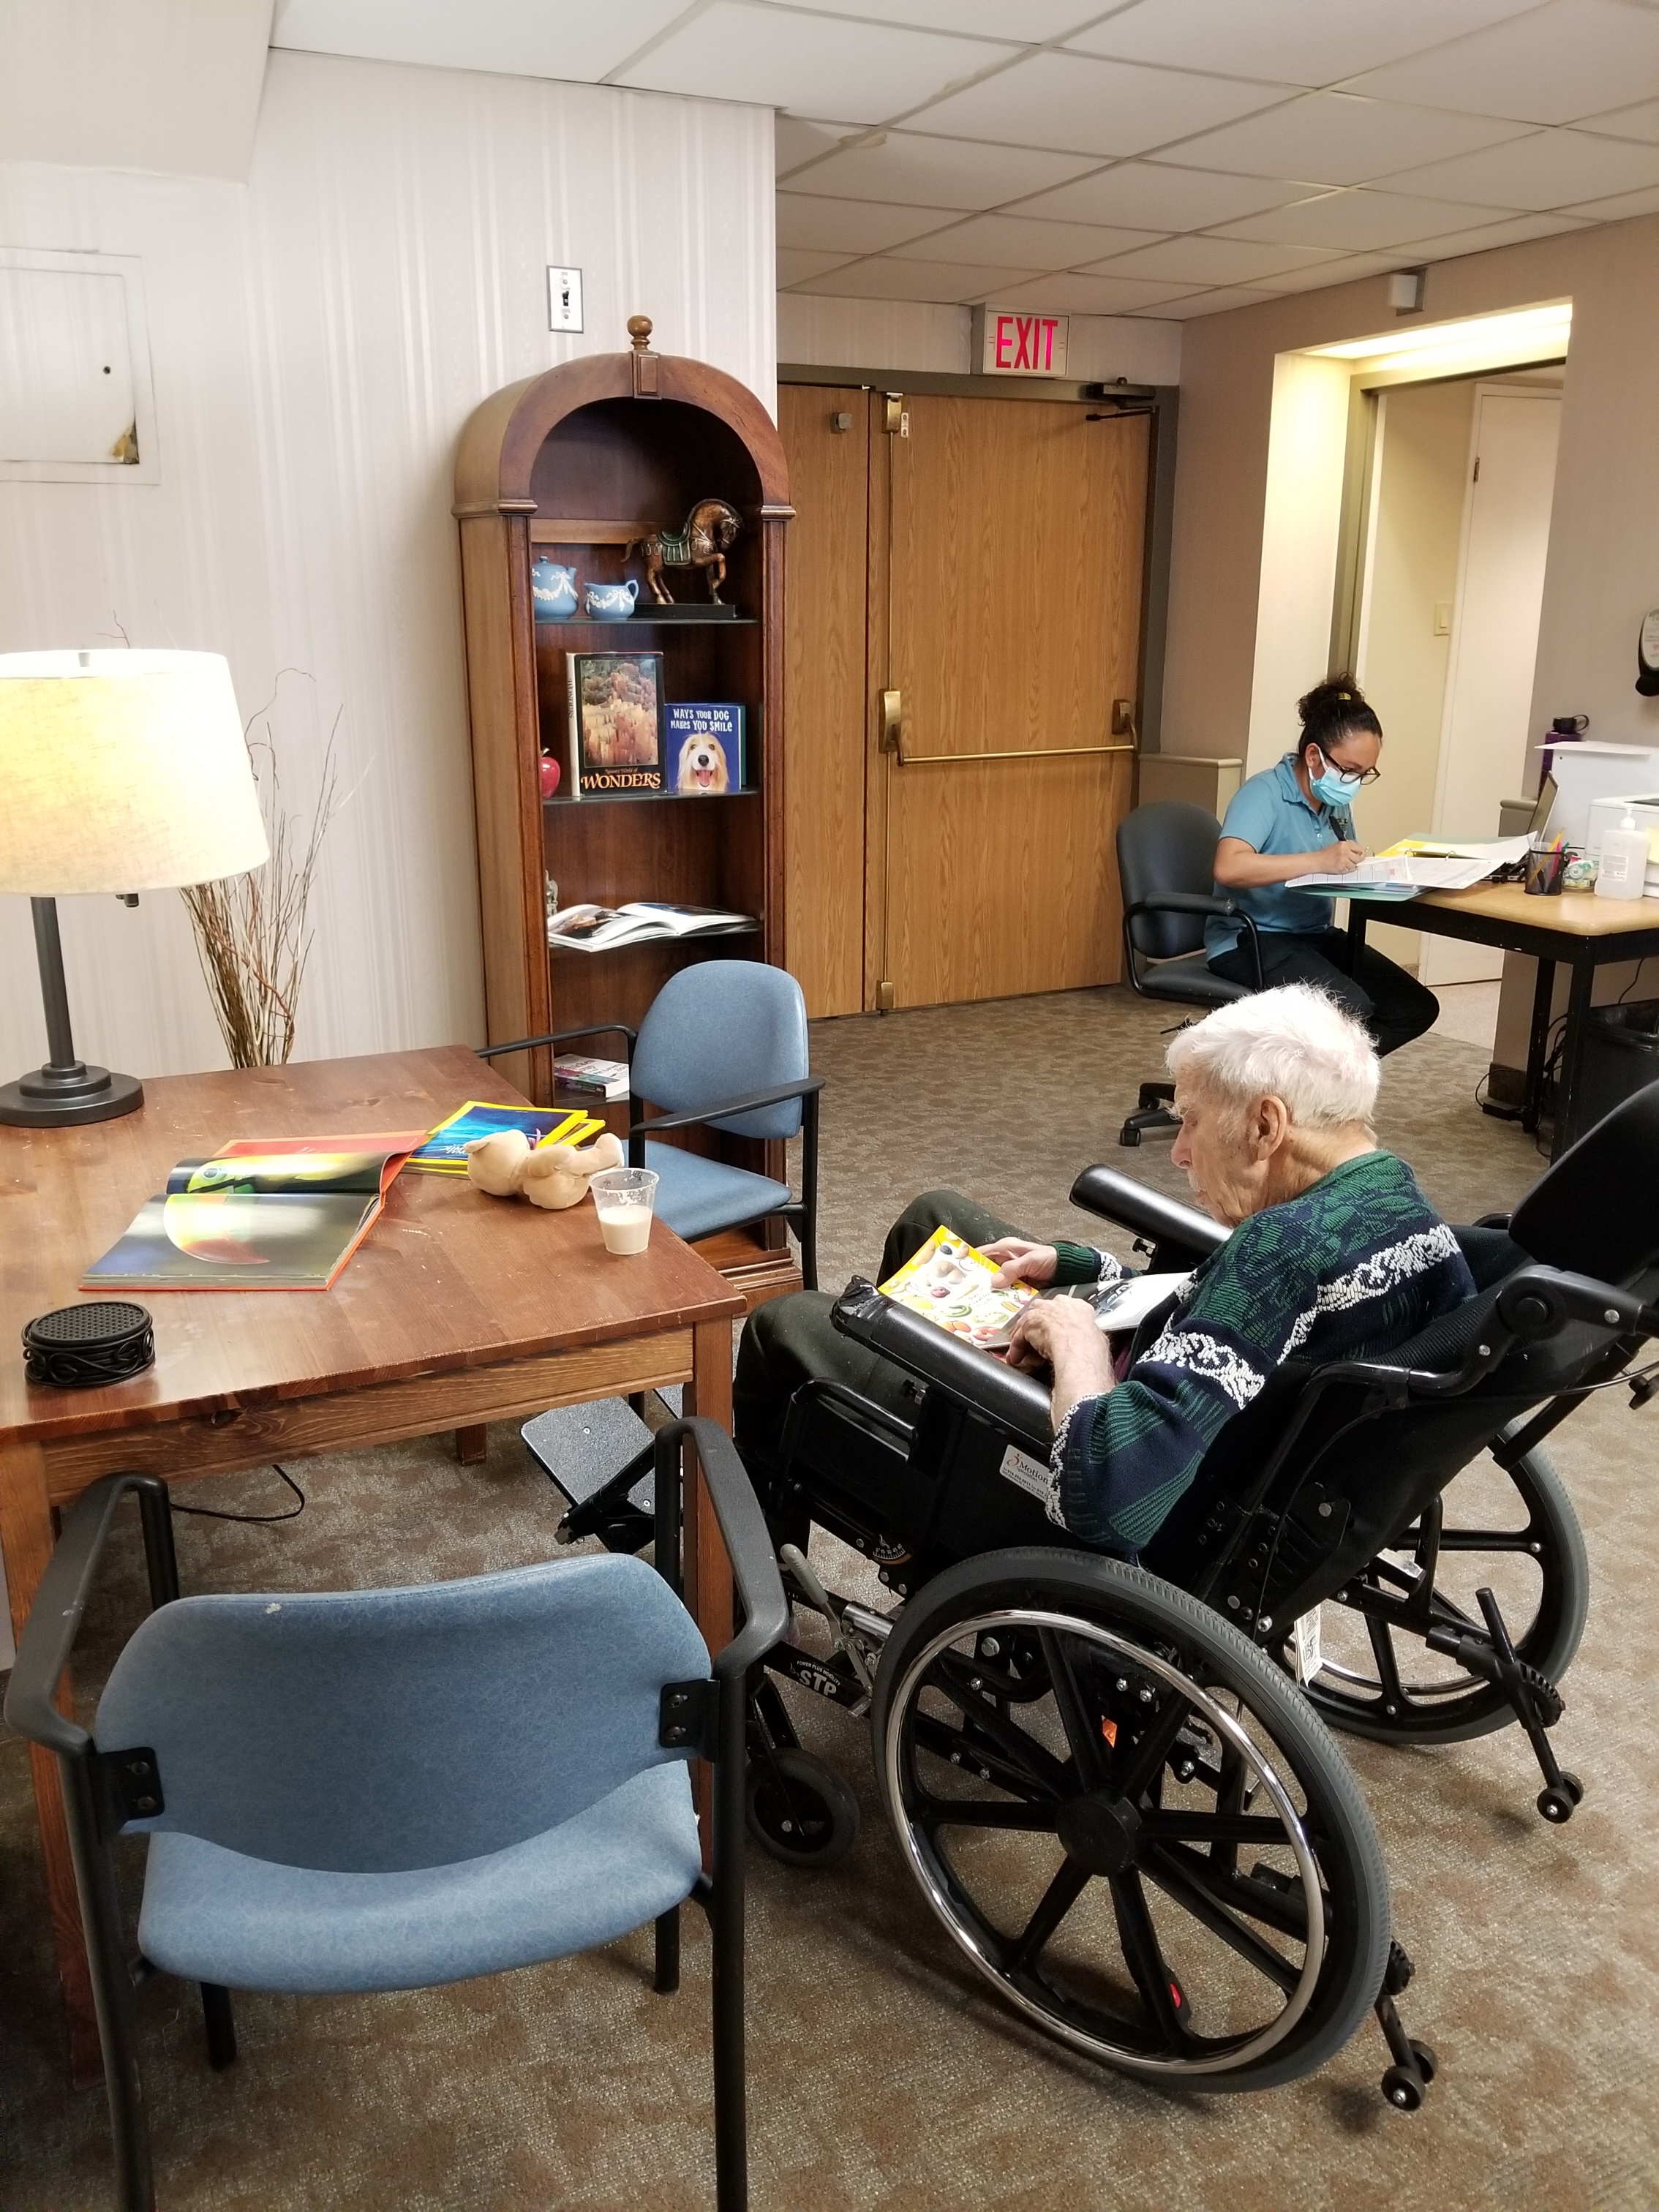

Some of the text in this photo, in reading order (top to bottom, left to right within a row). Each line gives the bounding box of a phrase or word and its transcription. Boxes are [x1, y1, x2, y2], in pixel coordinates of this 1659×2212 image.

[996, 316, 1058, 371] EXIT
[673, 708, 730, 721] WAYS YOUR DOG
[693, 720, 707, 731] YOU
[580, 772, 661, 790] WONDERS
[1019, 1461, 1049, 1485] Motion
[799, 1669, 837, 1696] STP
